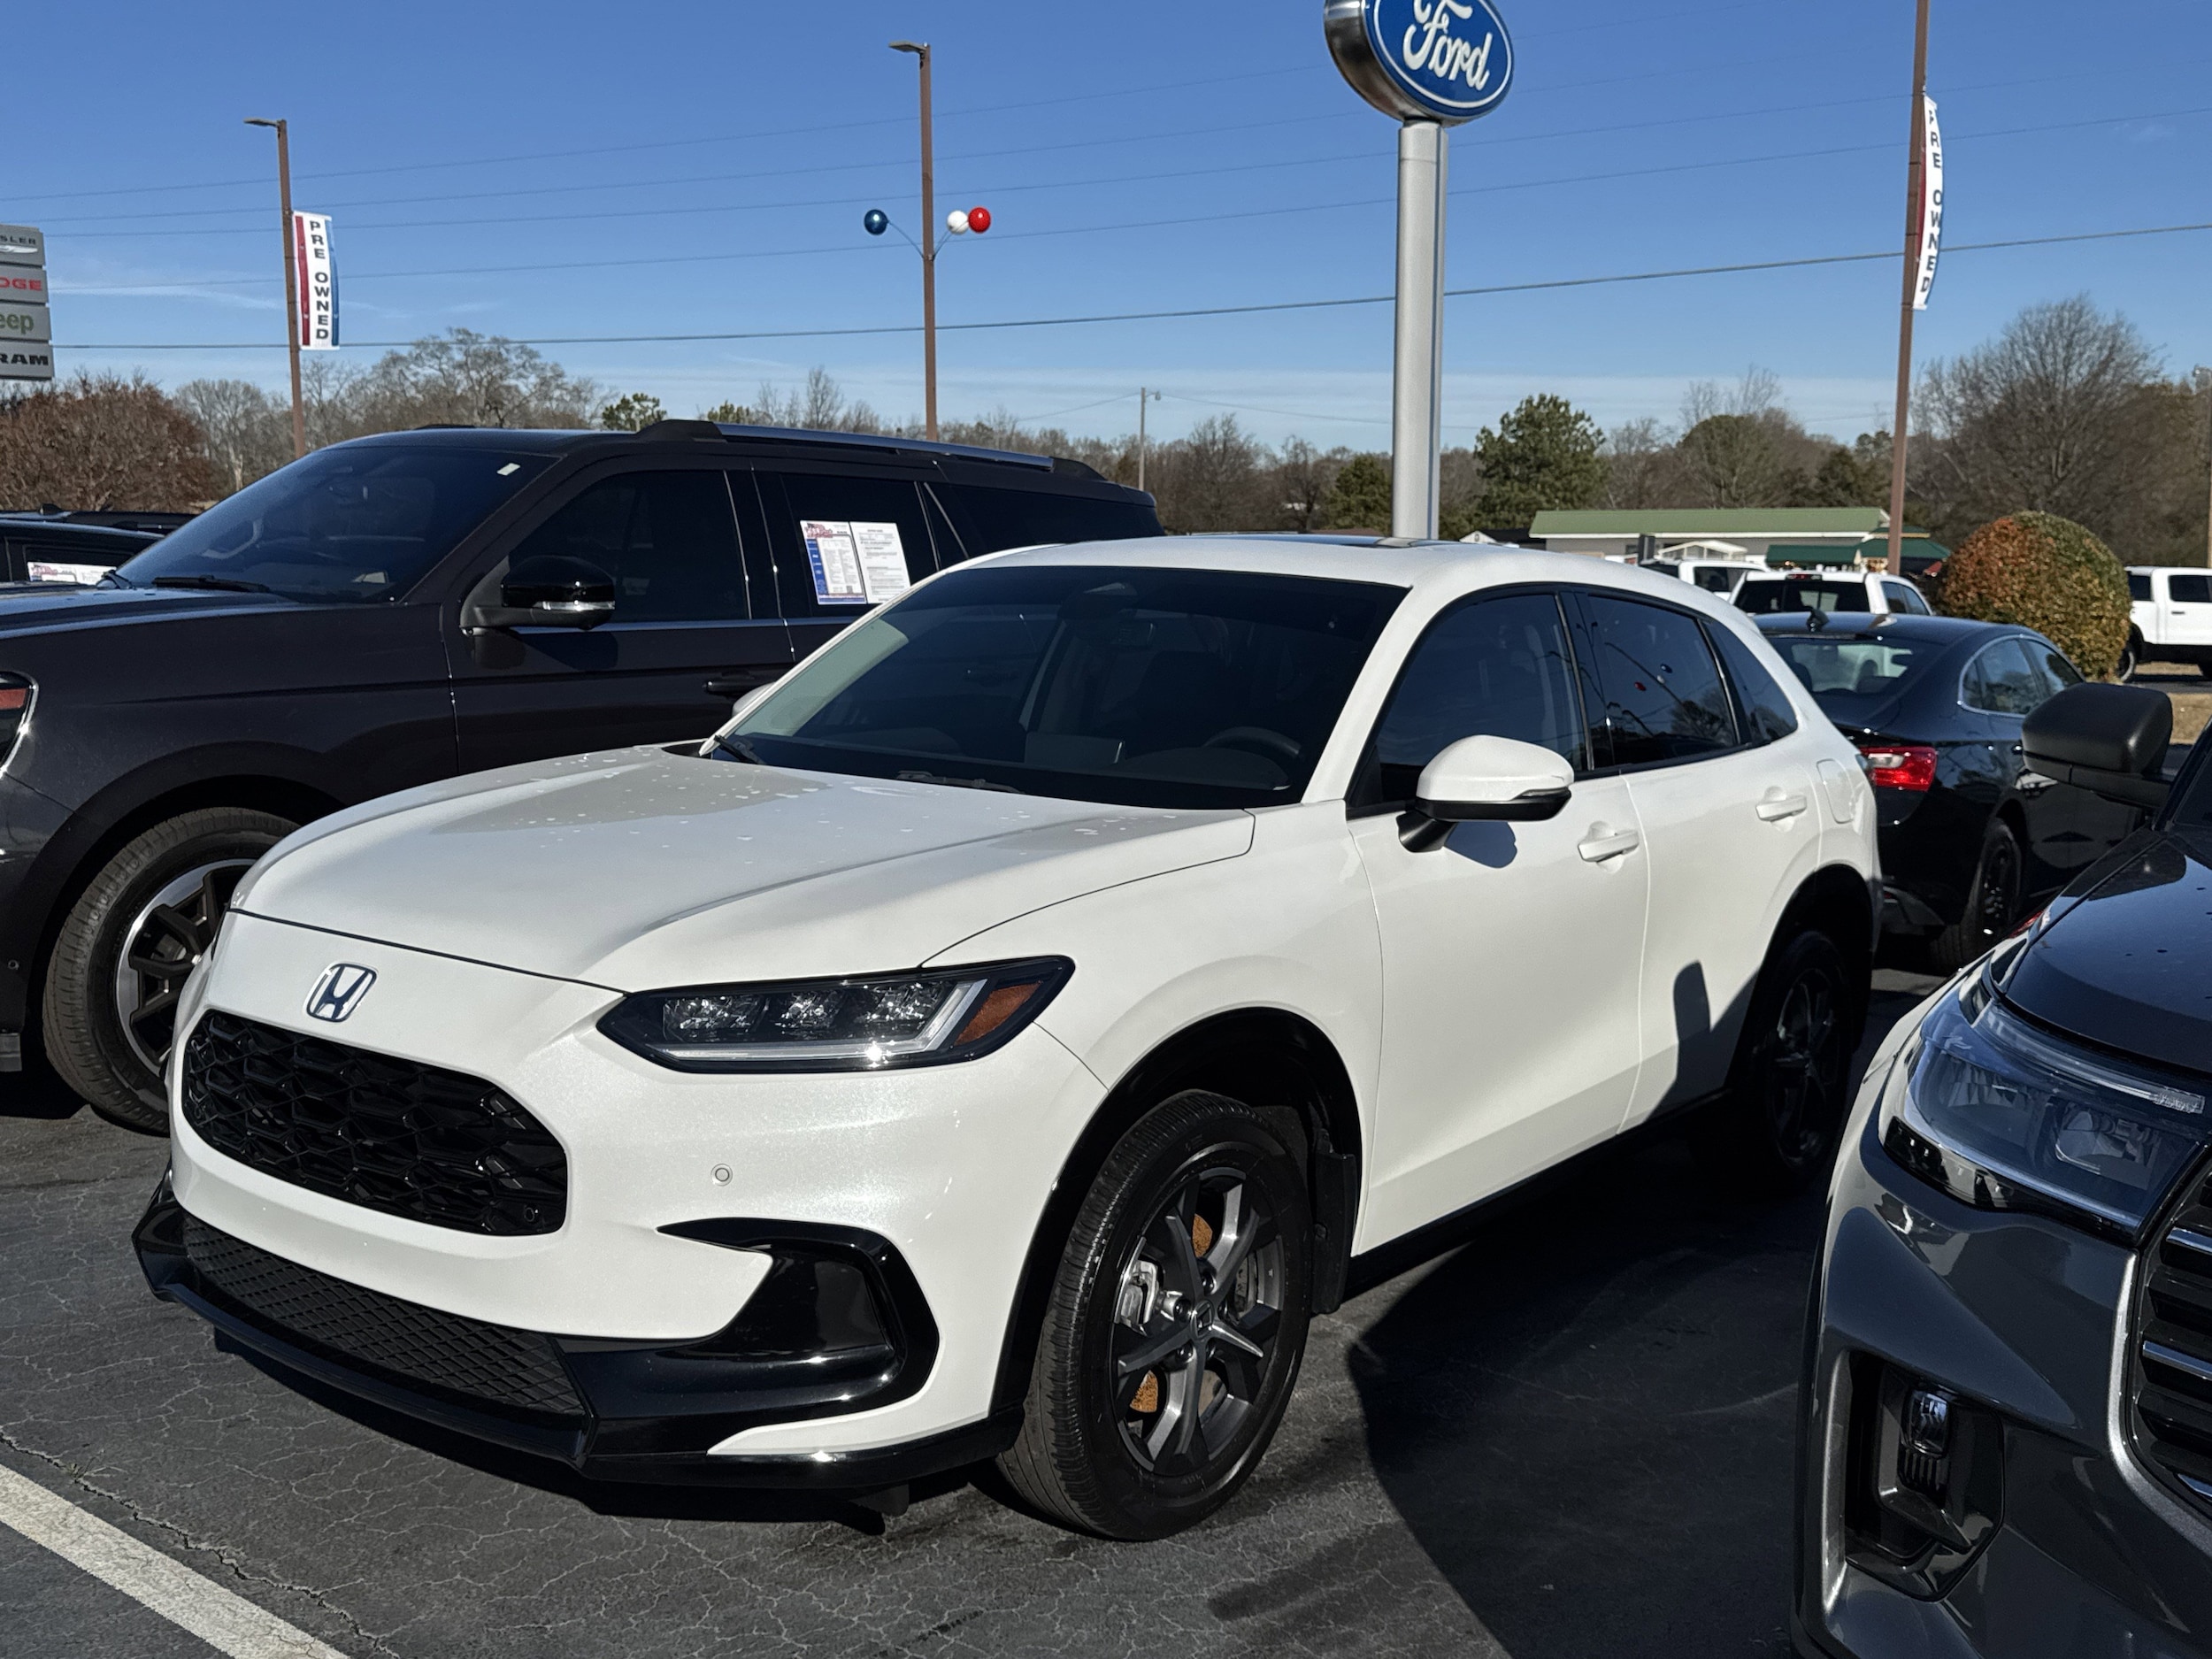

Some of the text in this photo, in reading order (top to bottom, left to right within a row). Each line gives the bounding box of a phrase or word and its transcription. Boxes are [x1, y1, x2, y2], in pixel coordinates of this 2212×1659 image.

[1403, 0, 1493, 91] Ford
[309, 219, 326, 259] PRE
[1920, 189, 1942, 293] OWNED
[314, 272, 330, 340] OWNED
